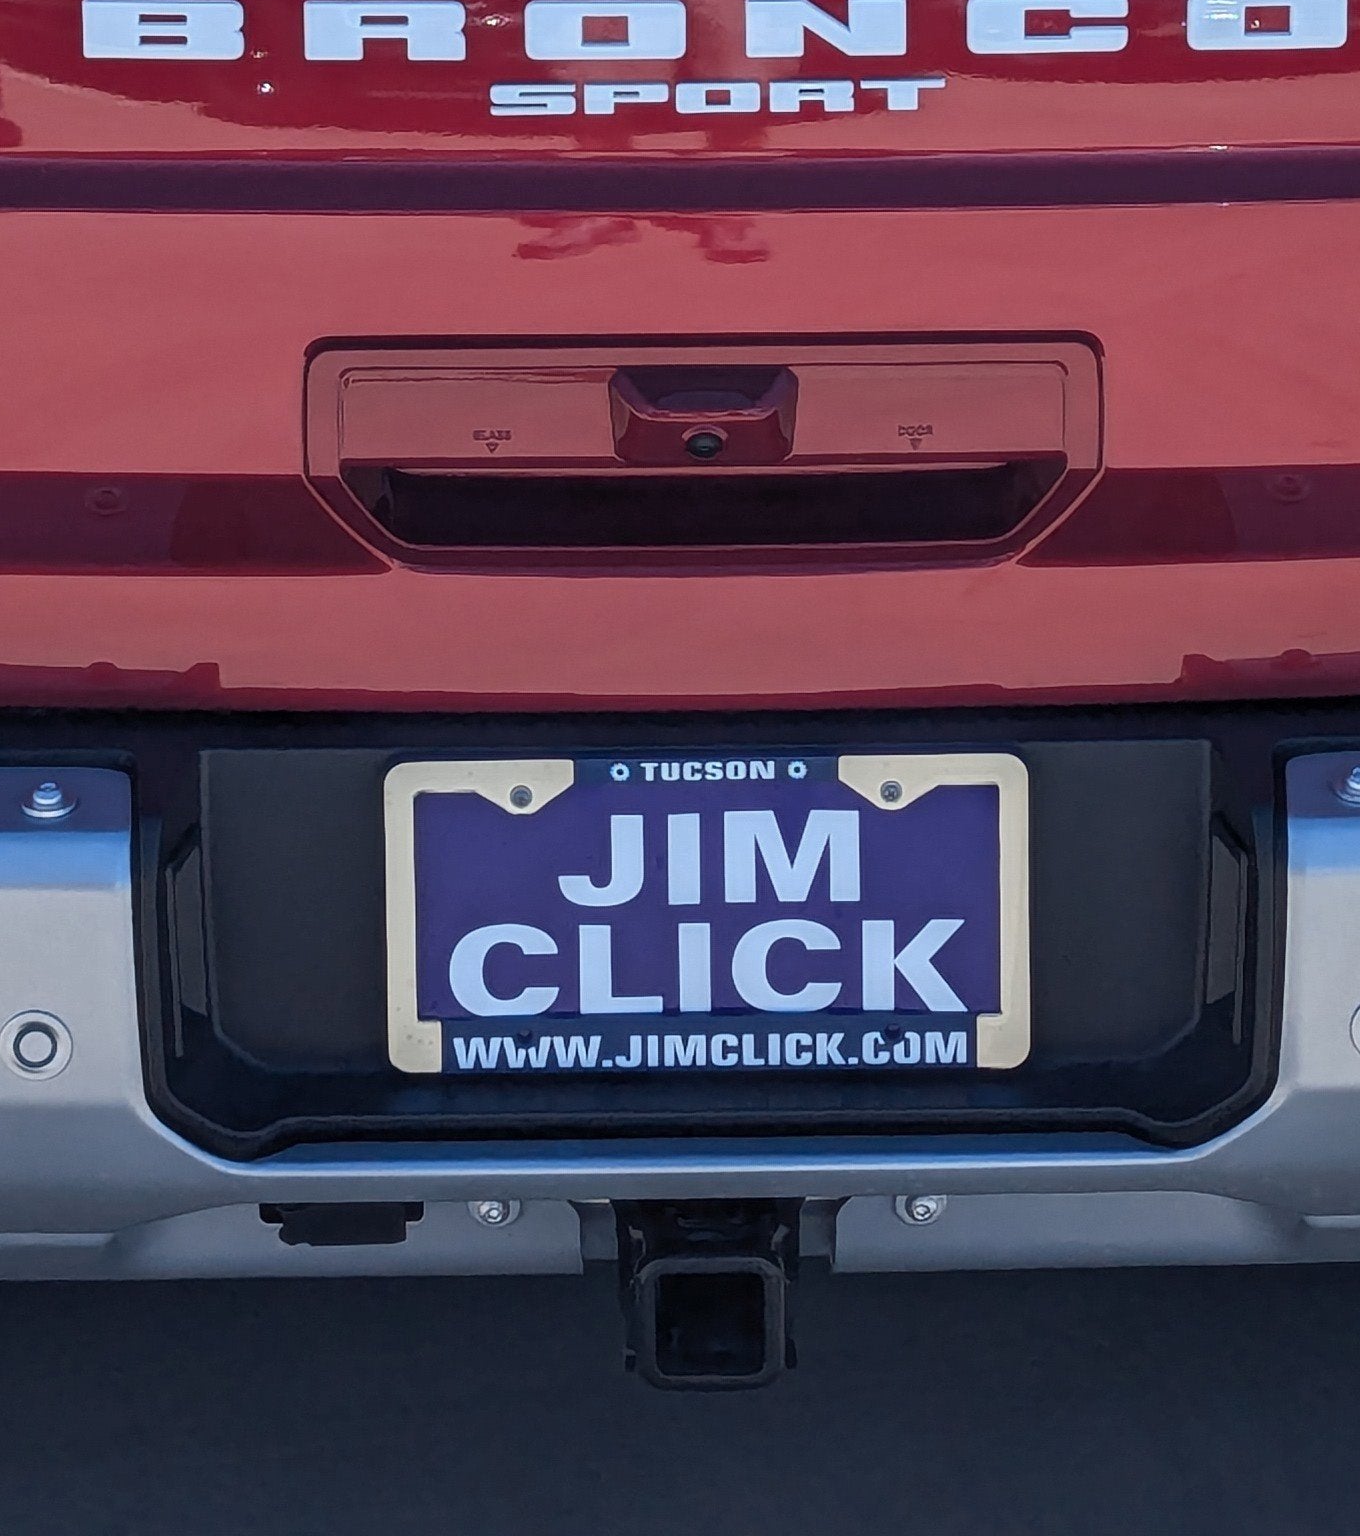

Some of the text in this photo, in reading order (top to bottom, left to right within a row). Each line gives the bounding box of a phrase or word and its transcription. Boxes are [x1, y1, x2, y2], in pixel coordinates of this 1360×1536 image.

[489, 78, 947, 117] SPORT
[639, 759, 776, 783] TUCSON
[557, 809, 862, 907] JIM
[448, 918, 969, 1017] CLICK
[452, 1030, 969, 1070] WWW.JIMCLICK.COM
